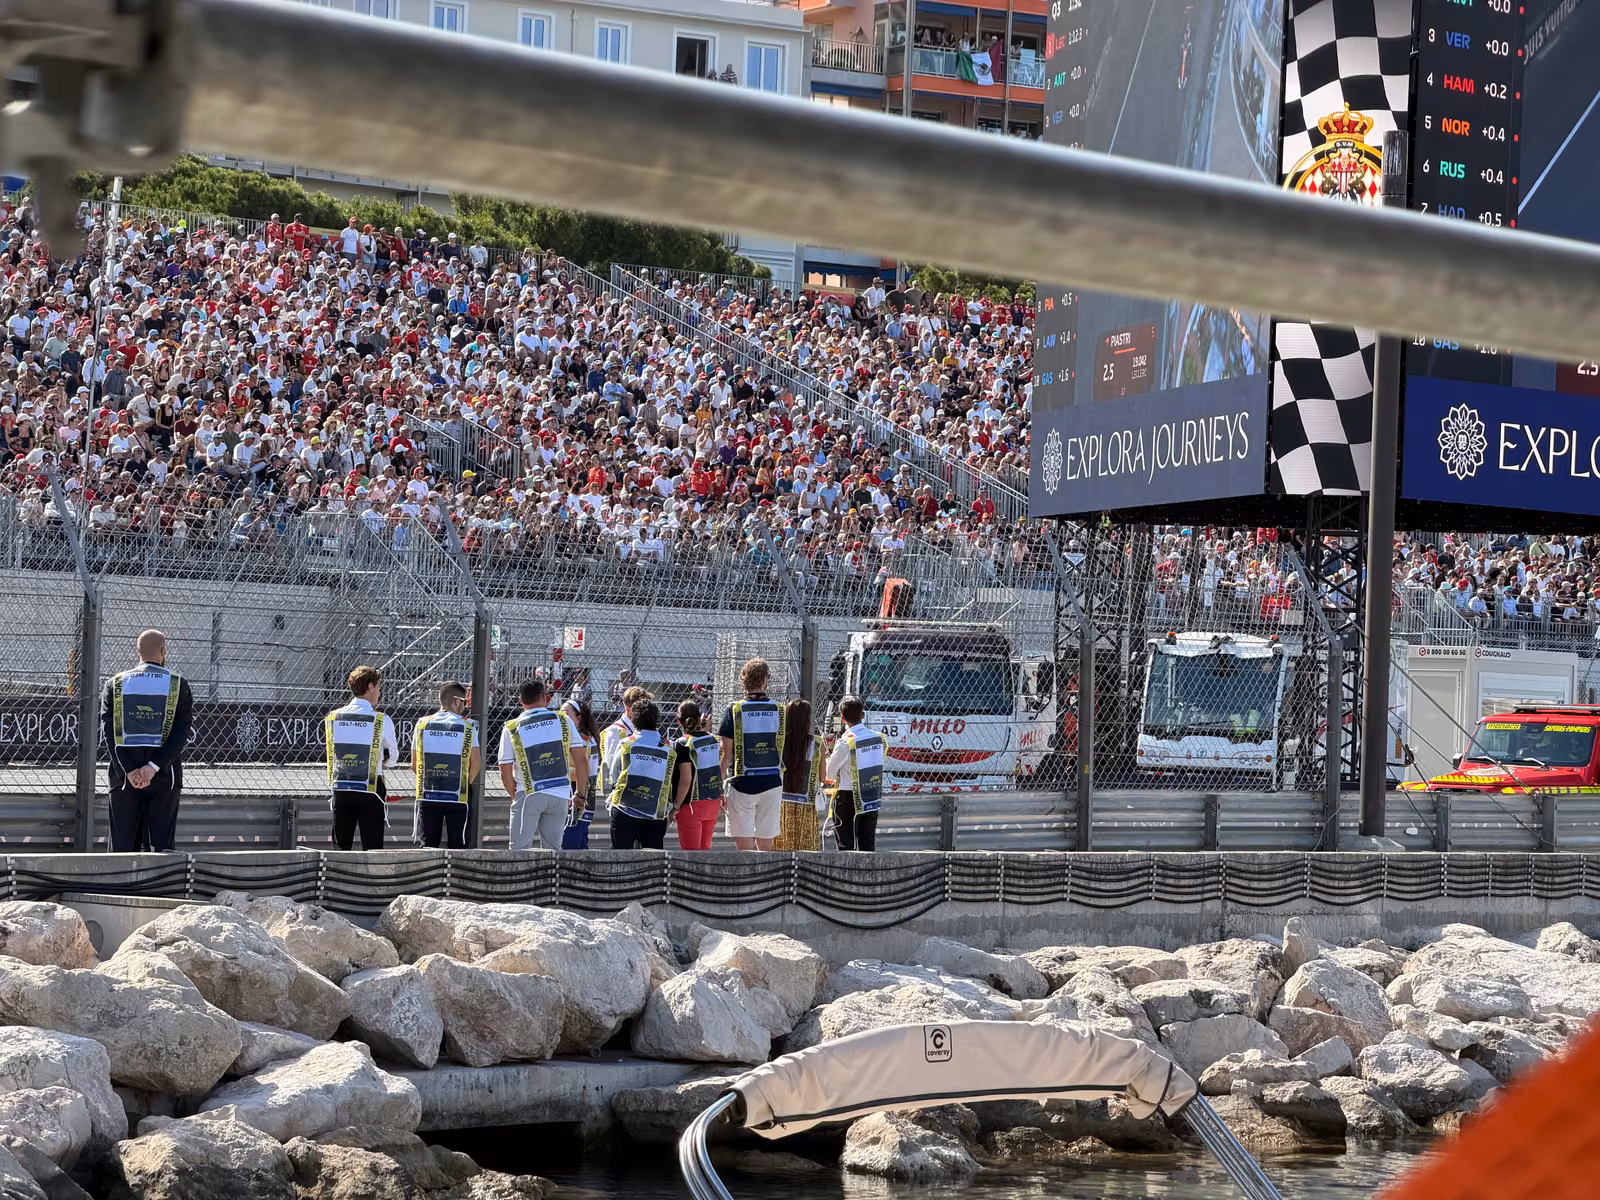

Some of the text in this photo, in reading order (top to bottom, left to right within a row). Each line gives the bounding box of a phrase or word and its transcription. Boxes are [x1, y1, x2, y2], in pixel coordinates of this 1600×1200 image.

[1487, 0, 1511, 14] +0.0
[1428, 28, 1509, 56] 3 VER +0.0
[1054, 72, 1067, 88] ANT
[1426, 72, 1507, 99] 4 HAM +0.2
[1424, 115, 1506, 142] 5 NOR +0.4
[1422, 159, 1504, 185] 6 RUS +0.4
[1420, 202, 1428, 216] 7
[1478, 211, 1502, 228] +0.5
[1044, 297, 1055, 312] PIA
[1043, 334, 1057, 349] LAW
[1041, 372, 1053, 386] GAS
[1102, 363, 1115, 382] 2.5
[1067, 411, 1249, 484] EXPLORA JOURNEYS
[1432, 647, 1442, 656] 800
[0, 713, 79, 744] EXPLOR
[910, 718, 966, 735] MILCO
[462, 727, 472, 759] MONACO
[520, 760, 533, 791] MONACO
[852, 781, 862, 812] MONACO
[927, 1049, 950, 1057] coversy
